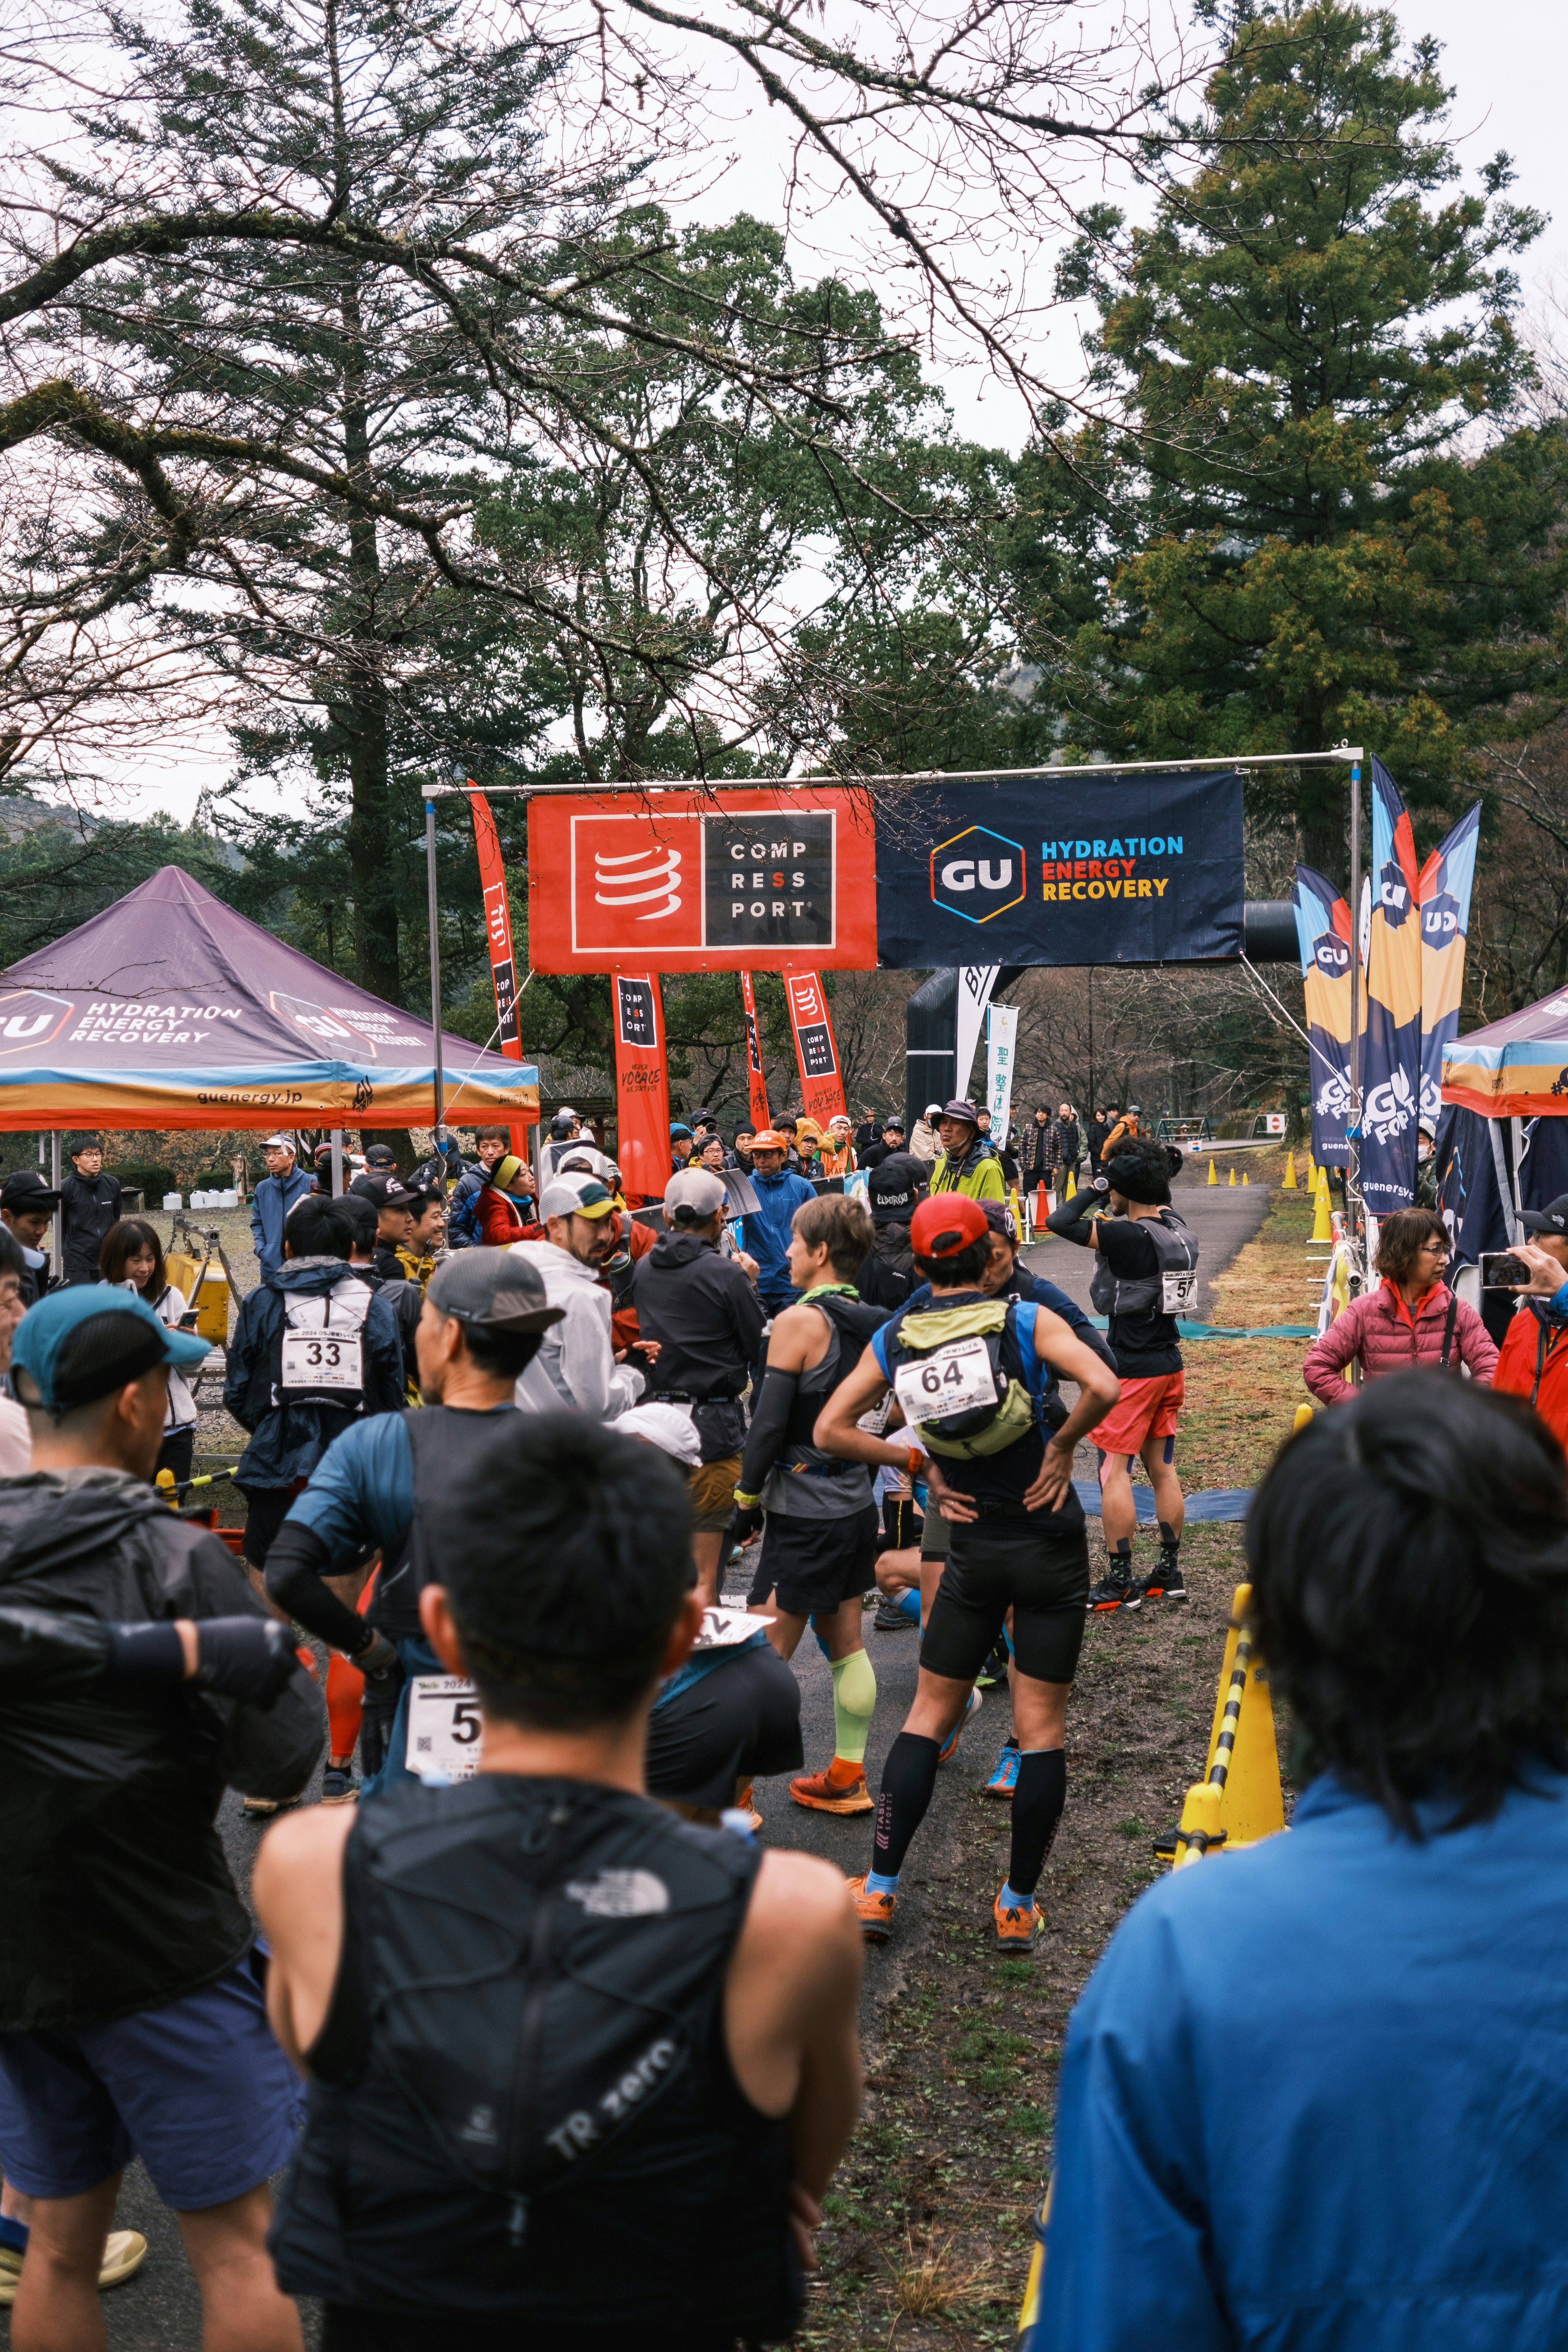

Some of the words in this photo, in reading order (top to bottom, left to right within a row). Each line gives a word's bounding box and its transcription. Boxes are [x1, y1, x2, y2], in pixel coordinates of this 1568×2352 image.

[731, 843, 806, 860] COMP
[1042, 836, 1183, 859] HYDRATION
[941, 859, 1012, 891] GU
[1043, 859, 1136, 879] ENERGY
[732, 872, 804, 888] RESS
[1043, 879, 1169, 900] RECOVERY
[1317, 946, 1348, 965] GU
[87, 1003, 242, 1019] HYDRATION
[328, 1007, 398, 1023] HYDRATION
[627, 1007, 643, 1017] ESS
[0, 1014, 53, 1037] U
[78, 1017, 184, 1031] ENERGY
[296, 1014, 351, 1037] GU
[346, 1020, 395, 1034] ENERGY
[626, 1021, 644, 1032] ORT
[69, 1030, 210, 1043] RECOVERY
[364, 1033, 427, 1046] RECOVERY
[807, 1035, 823, 1044] COMP
[809, 1046, 825, 1055] RESS
[198, 1089, 302, 1104] guenergy.jp
[1177, 1279, 1194, 1298] 57
[306, 1342, 340, 1366] 33
[922, 1360, 964, 1393] 64
[877, 1793, 885, 1830] TABIO
